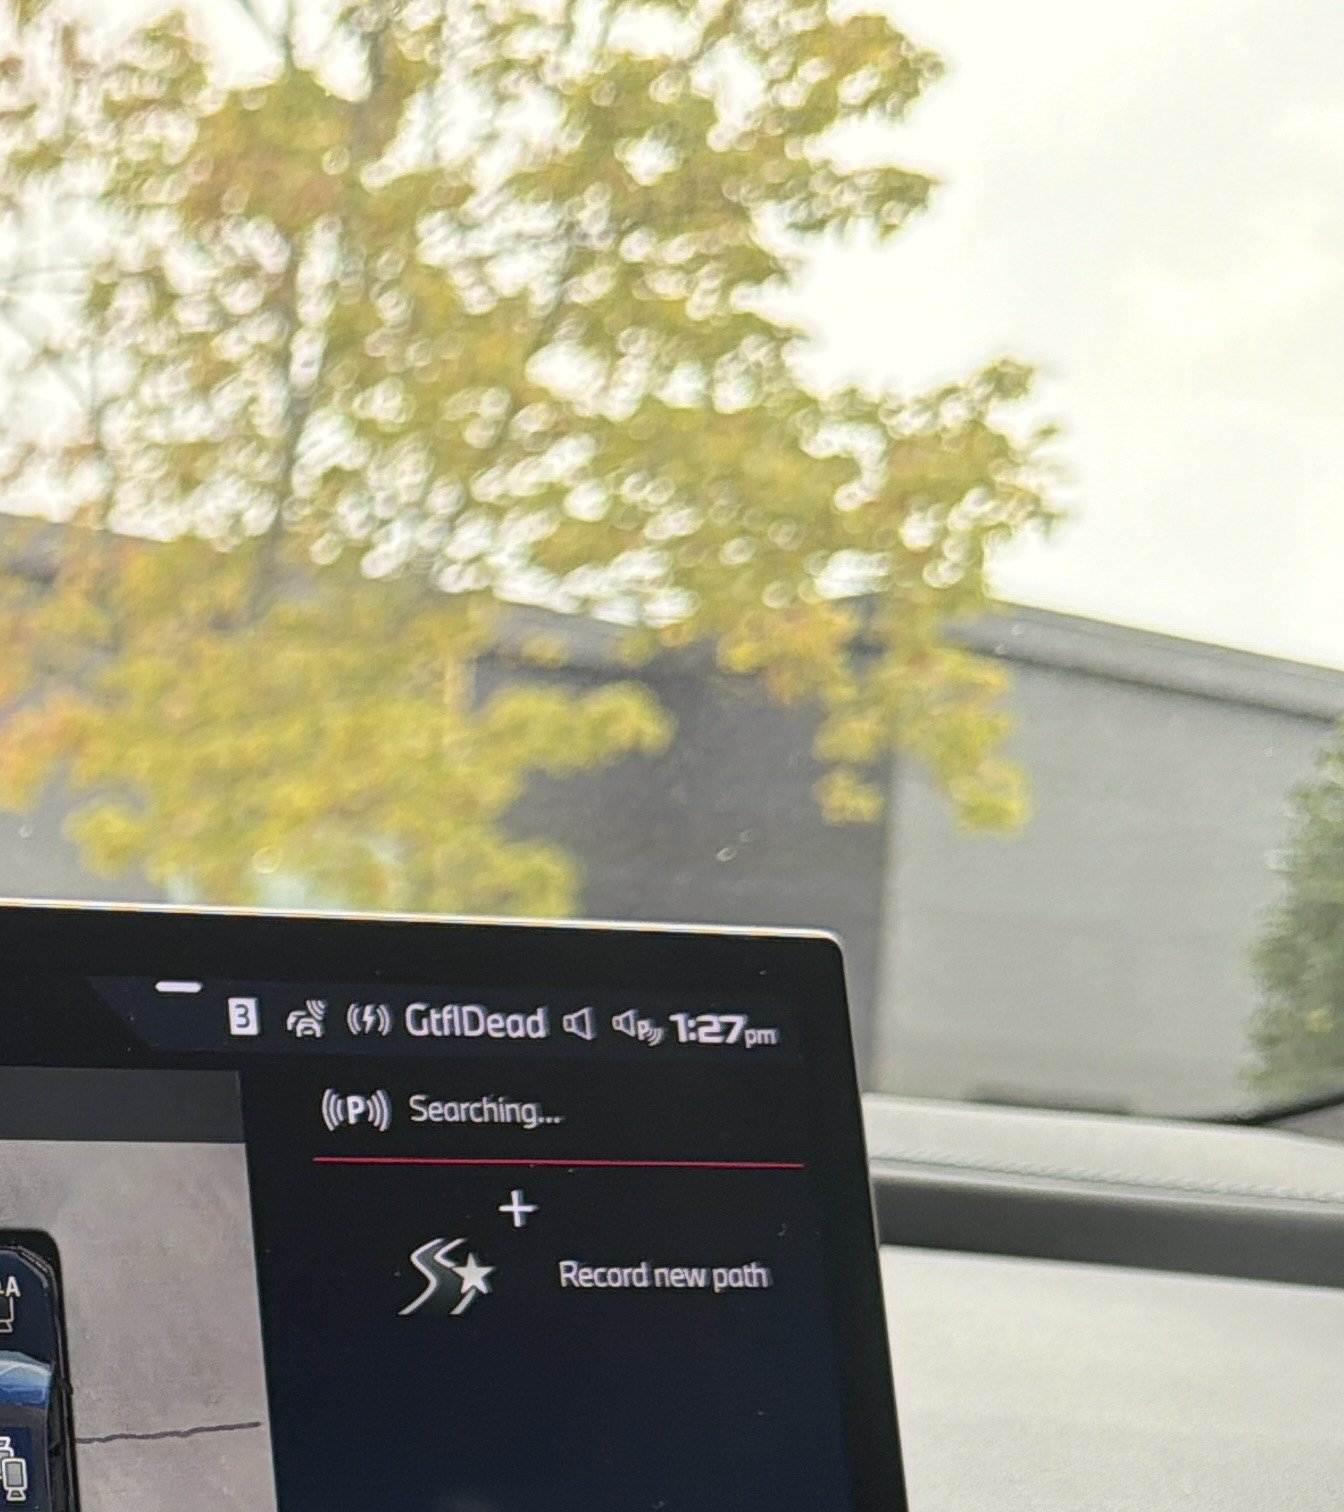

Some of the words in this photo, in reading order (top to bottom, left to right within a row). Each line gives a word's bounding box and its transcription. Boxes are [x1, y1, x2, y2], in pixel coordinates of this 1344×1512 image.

[409, 1095, 565, 1126] Searching...
[559, 1260, 650, 1288] Record
[654, 1267, 707, 1288] new
[712, 1261, 771, 1294] path
